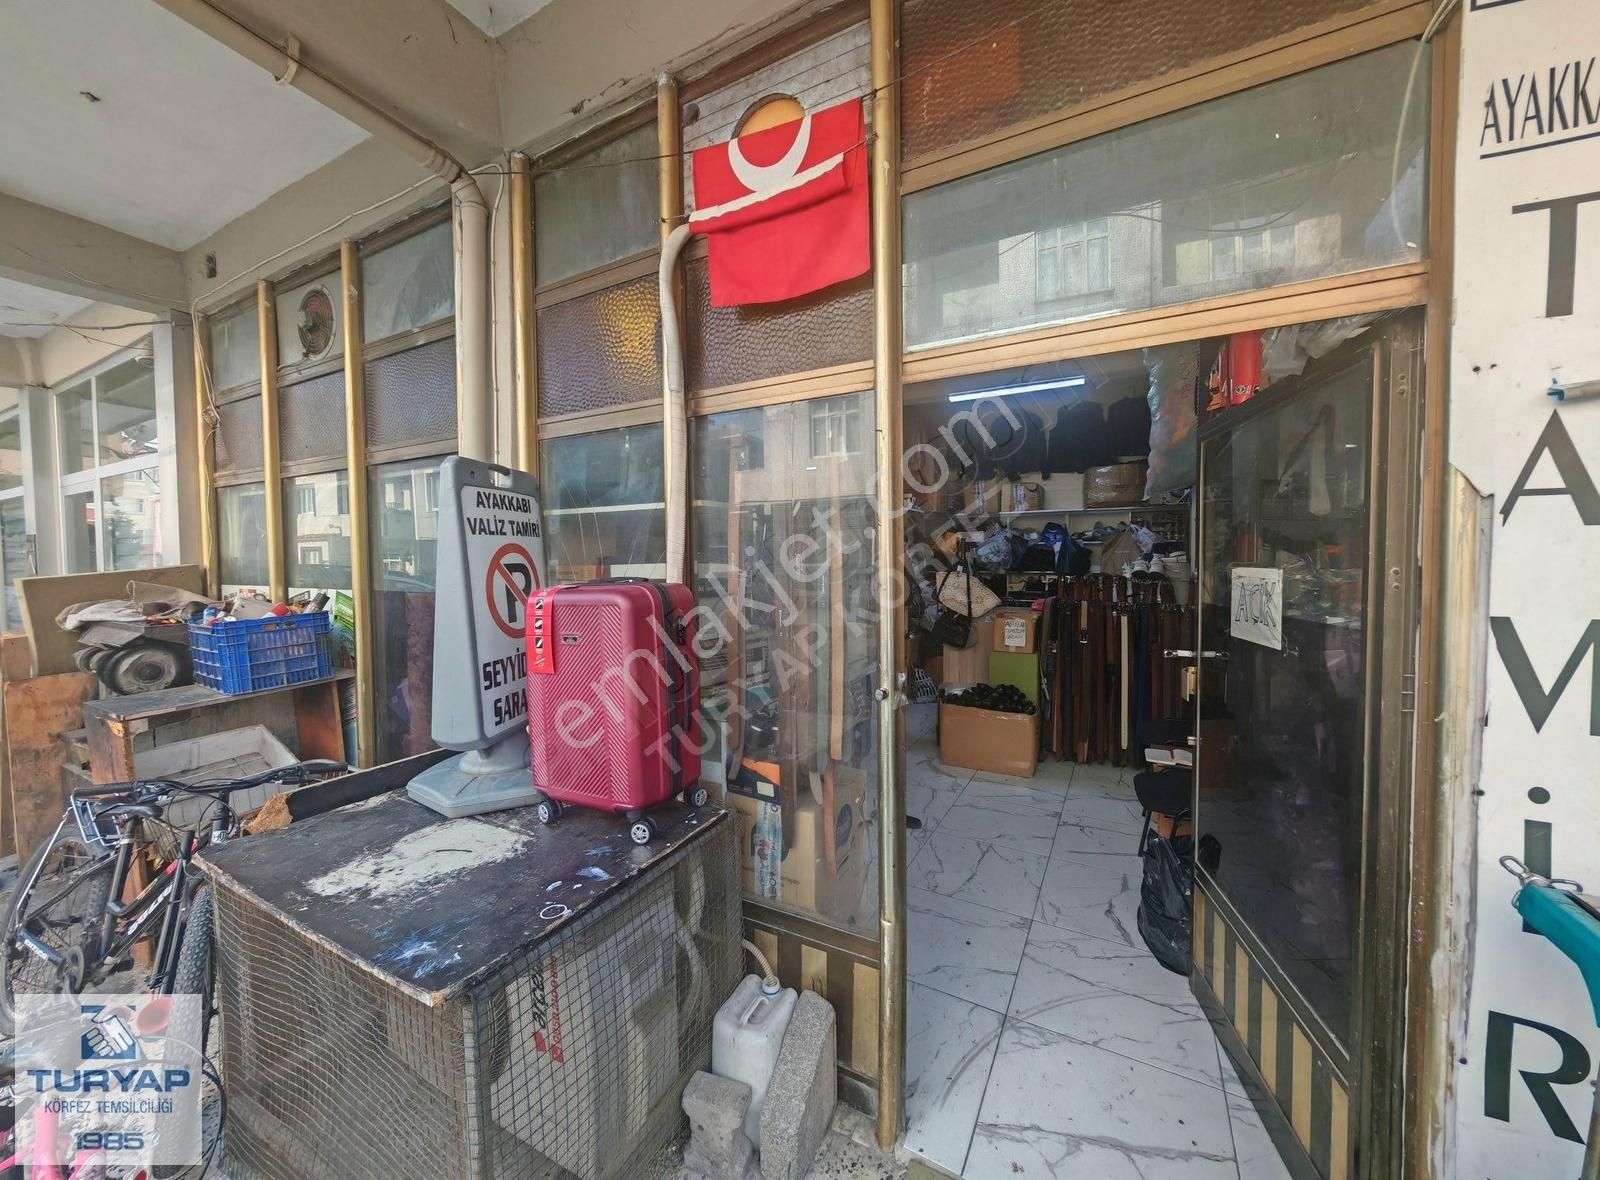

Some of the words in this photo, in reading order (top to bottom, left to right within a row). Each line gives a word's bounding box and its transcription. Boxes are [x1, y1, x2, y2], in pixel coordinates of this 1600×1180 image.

[1480, 57, 1600, 147] AYAKK
[476, 491, 531, 514] AYAKKABI
[467, 515, 507, 536] VALİZ
[508, 518, 540, 538] TAMİRİ
[1235, 581, 1276, 628] AÇIK
[494, 688, 528, 726] SARA
